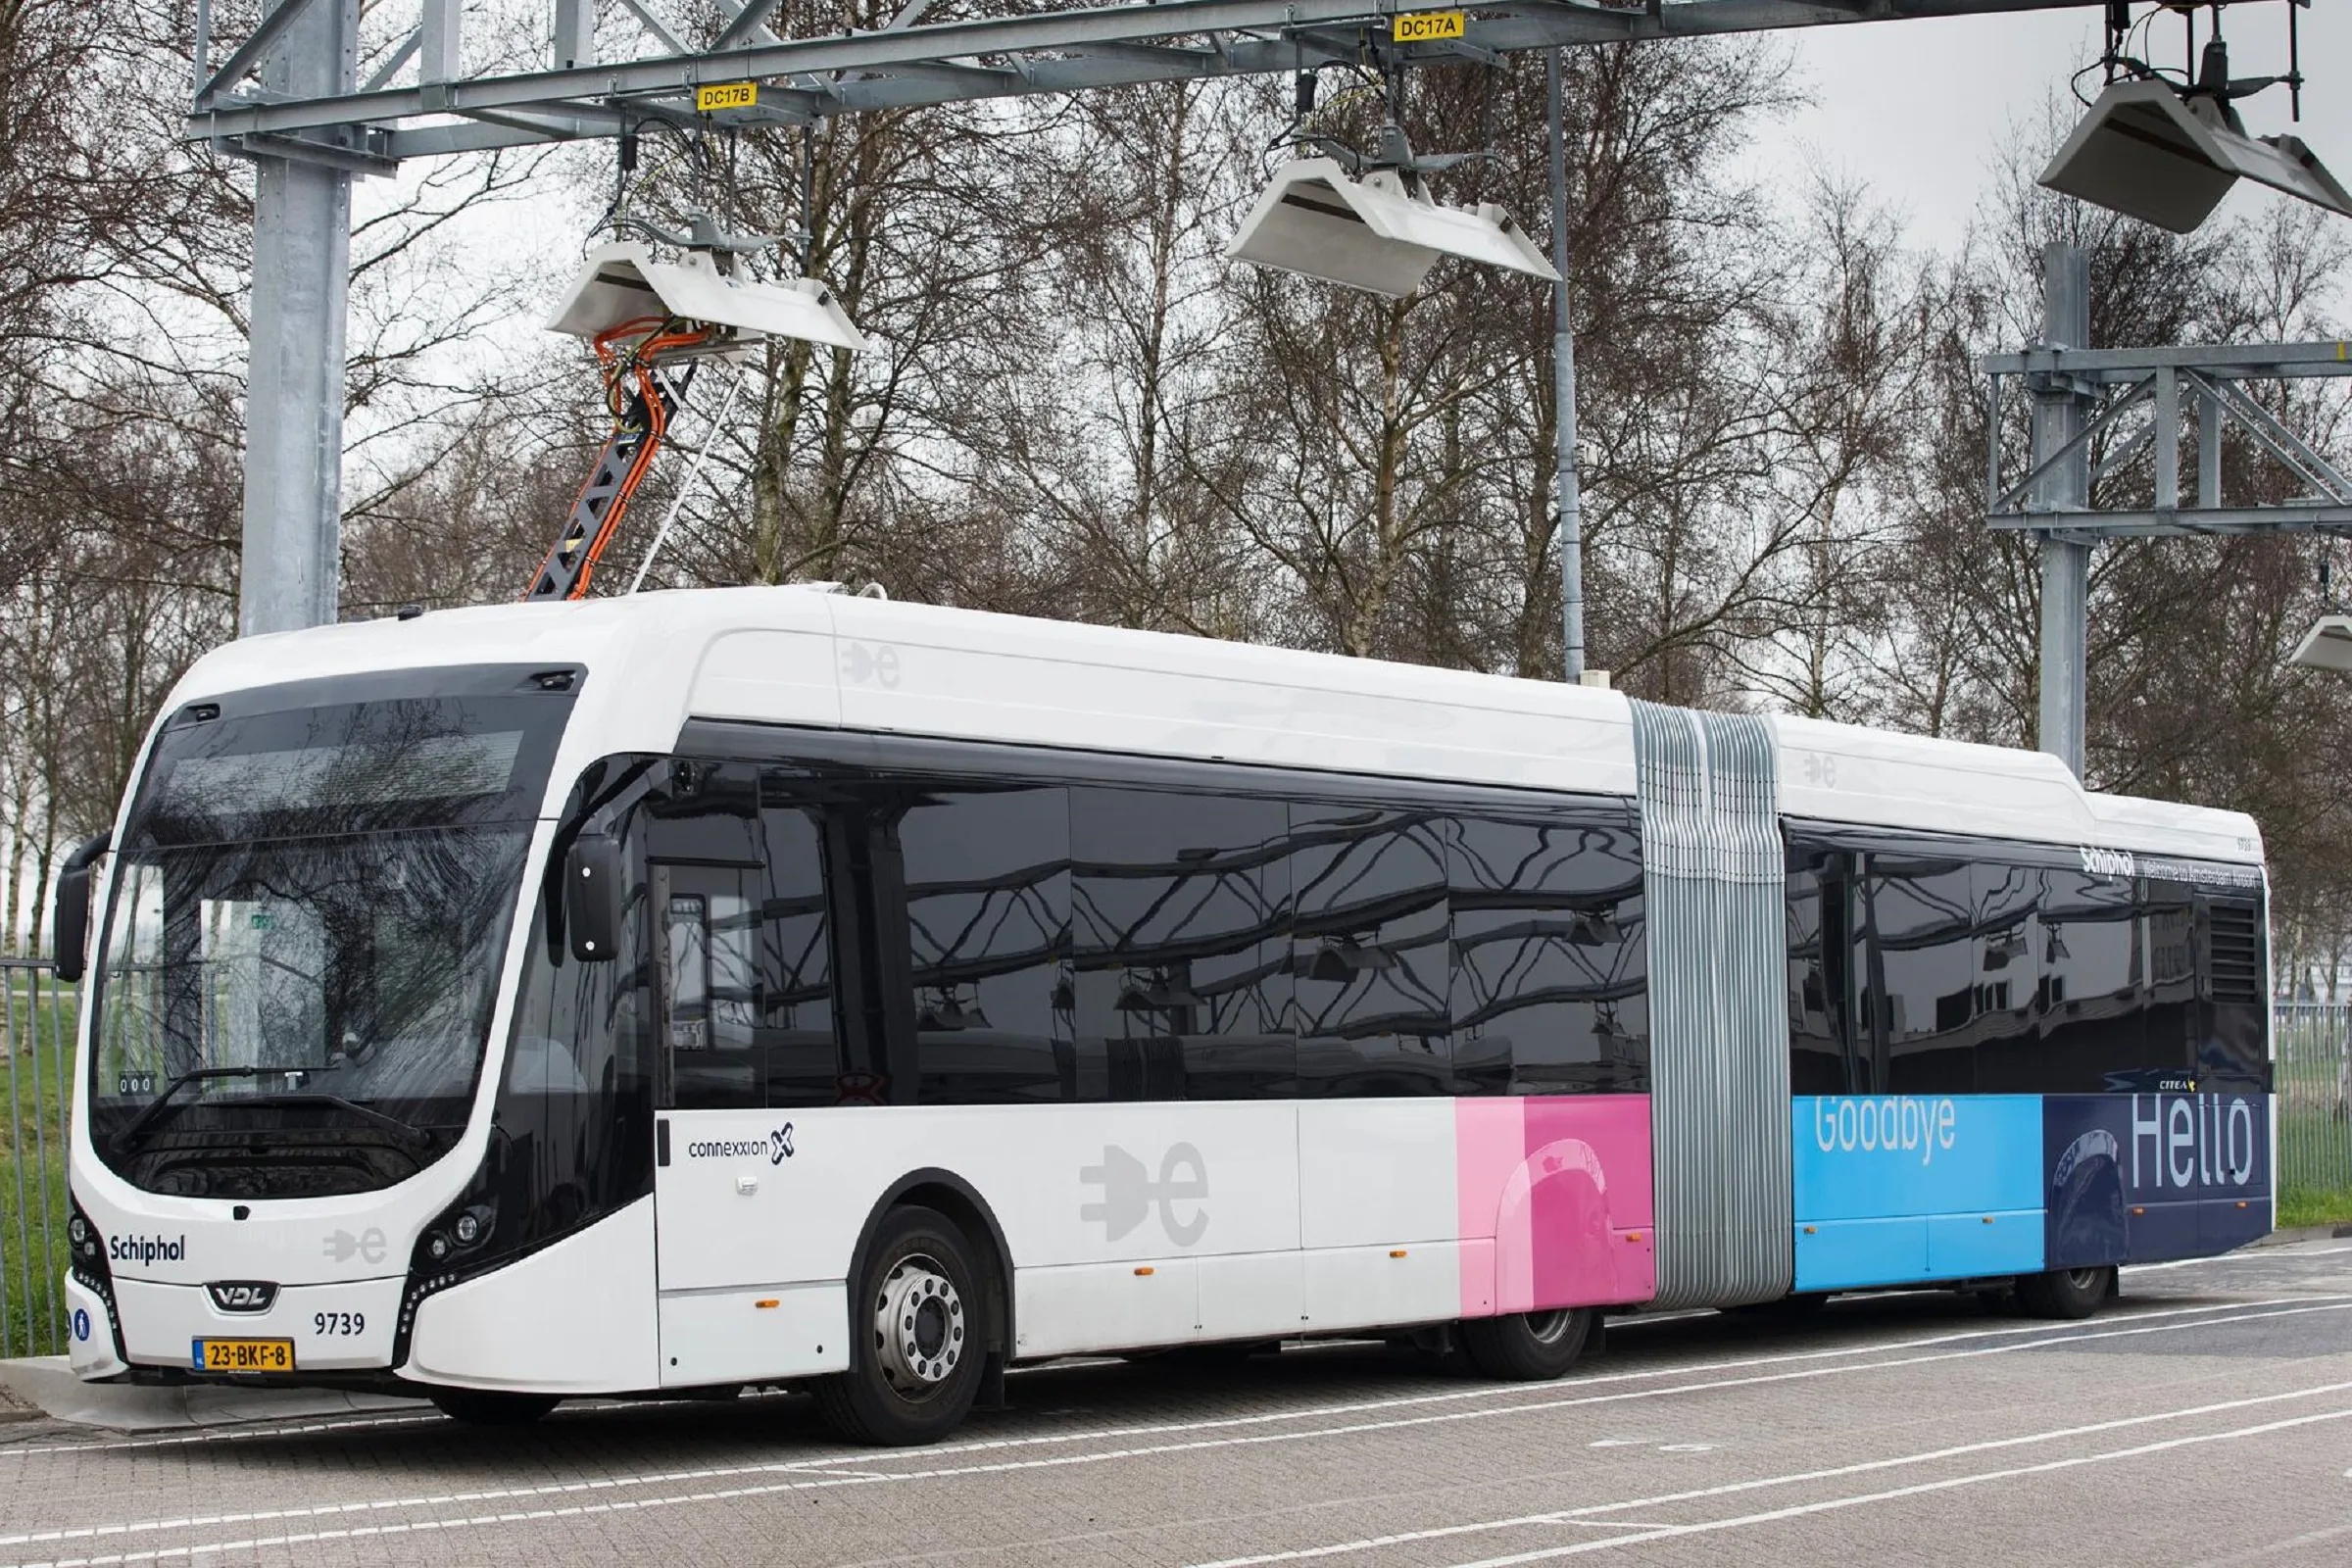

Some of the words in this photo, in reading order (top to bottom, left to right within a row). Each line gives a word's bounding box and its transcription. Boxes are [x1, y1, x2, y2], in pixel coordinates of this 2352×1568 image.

[1401, 18, 1455, 36] DC17A
[705, 88, 750, 106] DC17B
[2080, 847, 2135, 881] Schiphol
[2141, 858, 2179, 881] Welcome
[2179, 866, 2188, 882] to
[2188, 865, 2231, 886] Amsterdam
[2159, 1080, 2188, 1090] CITEA
[1816, 1095, 1955, 1166] Goodbye
[2132, 1093, 2252, 1188] Hello
[688, 1140, 768, 1157] connexxion
[110, 1234, 185, 1267] Schiphol
[216, 1287, 267, 1306] VDL
[314, 1312, 366, 1336] 9739
[210, 1345, 286, 1366] 23-BKF-8
